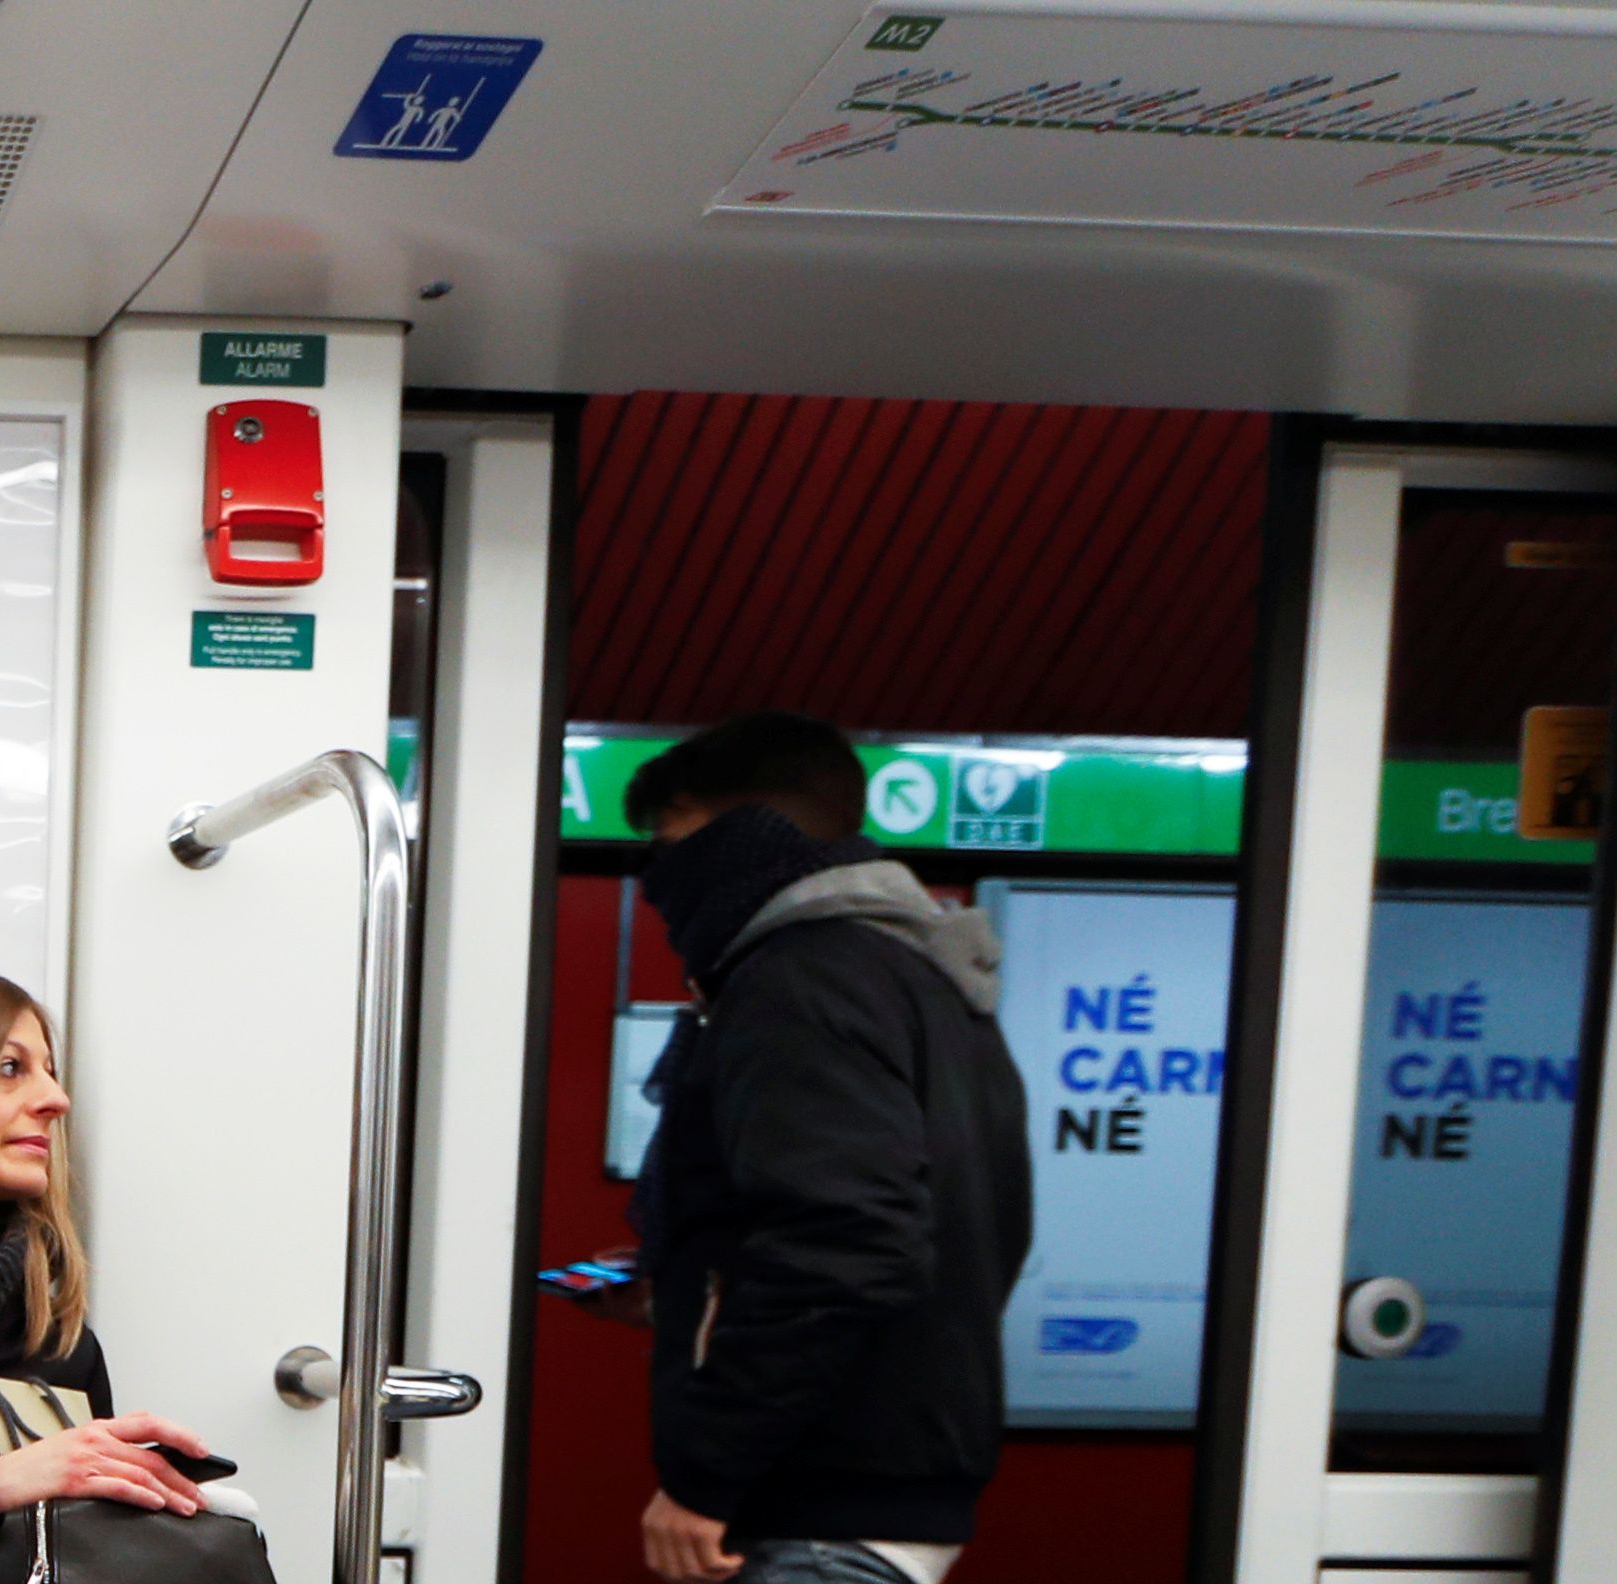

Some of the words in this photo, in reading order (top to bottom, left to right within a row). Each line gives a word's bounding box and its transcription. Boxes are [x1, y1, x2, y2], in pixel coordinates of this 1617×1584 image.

[874, 23, 931, 44] M2
[223, 341, 303, 359] ALLARME
[235, 361, 291, 378] ALARM
[1062, 975, 1158, 1035] NÉ
[1390, 981, 1486, 1042] NÉ
[1054, 1097, 1146, 1154] NÉ
[1379, 1104, 1473, 1161] NÉ
